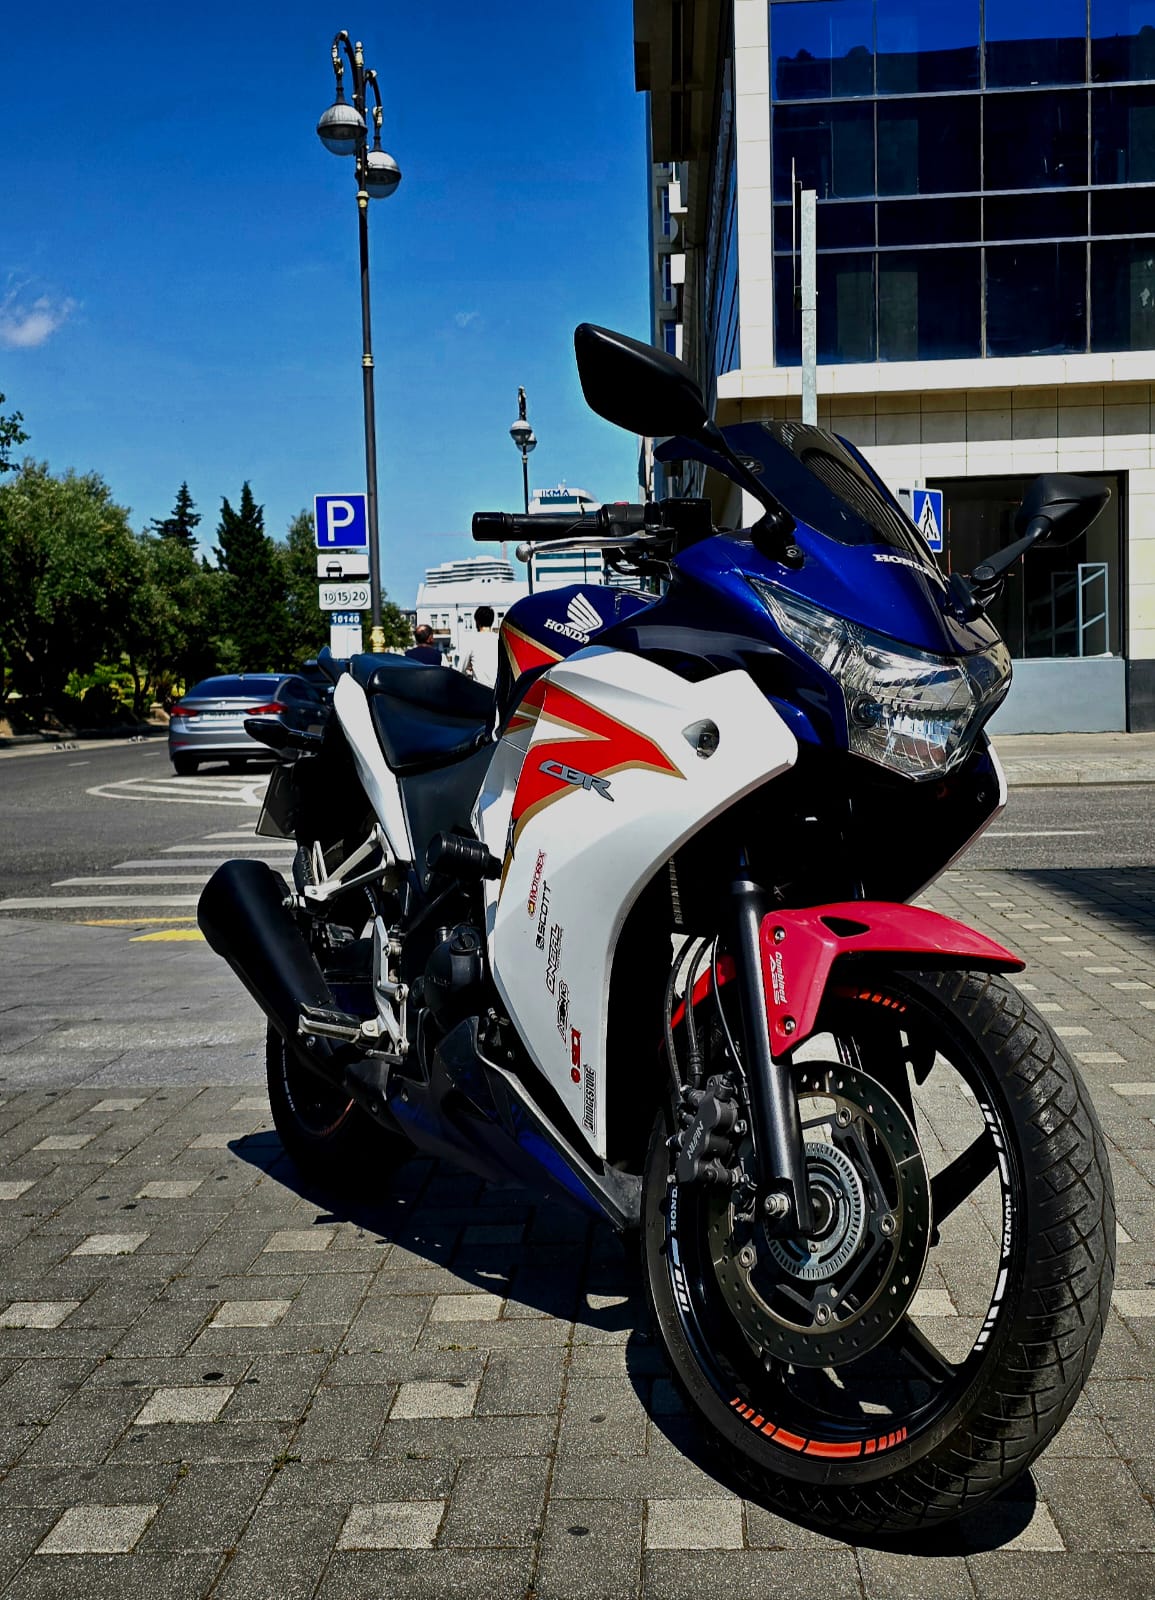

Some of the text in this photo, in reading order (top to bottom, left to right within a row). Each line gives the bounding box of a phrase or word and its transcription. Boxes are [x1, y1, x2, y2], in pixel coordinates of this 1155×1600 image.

[326, 500, 355, 542] P
[324, 591, 366, 602] 10 15 20
[543, 617, 591, 645] HONDA
[539, 759, 615, 803] CBR
[538, 880, 551, 938] SCOTT
[775, 951, 788, 1004] Combined
[670, 1186, 679, 1231] HOND
[1002, 1193, 1012, 1258] HONDA
